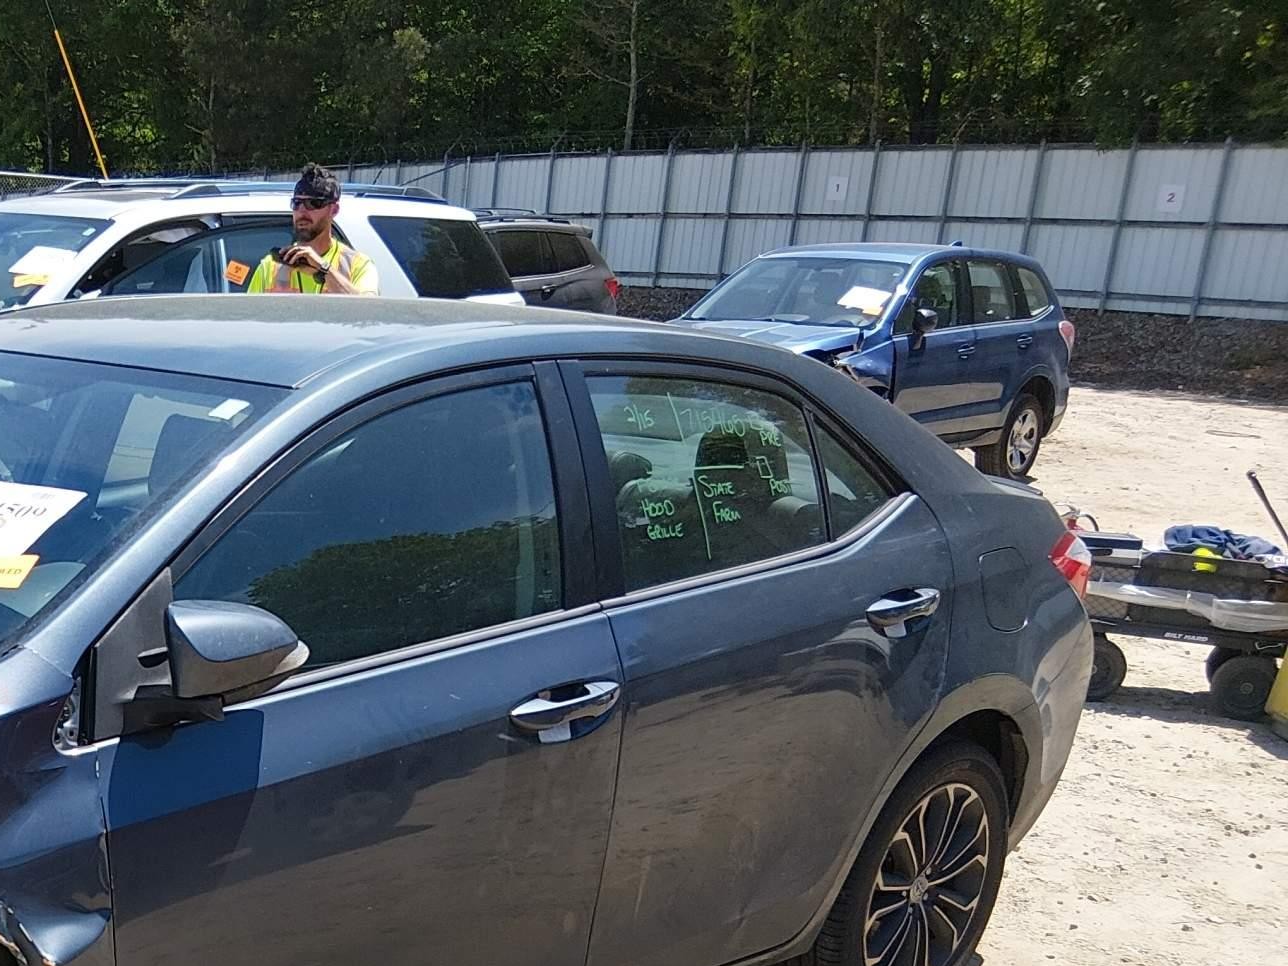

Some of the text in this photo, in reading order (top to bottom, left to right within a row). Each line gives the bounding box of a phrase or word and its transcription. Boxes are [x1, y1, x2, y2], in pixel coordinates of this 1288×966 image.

[1167, 192, 1177, 203] 2
[759, 430, 782, 447] PRE
[640, 498, 675, 520] HOOD
